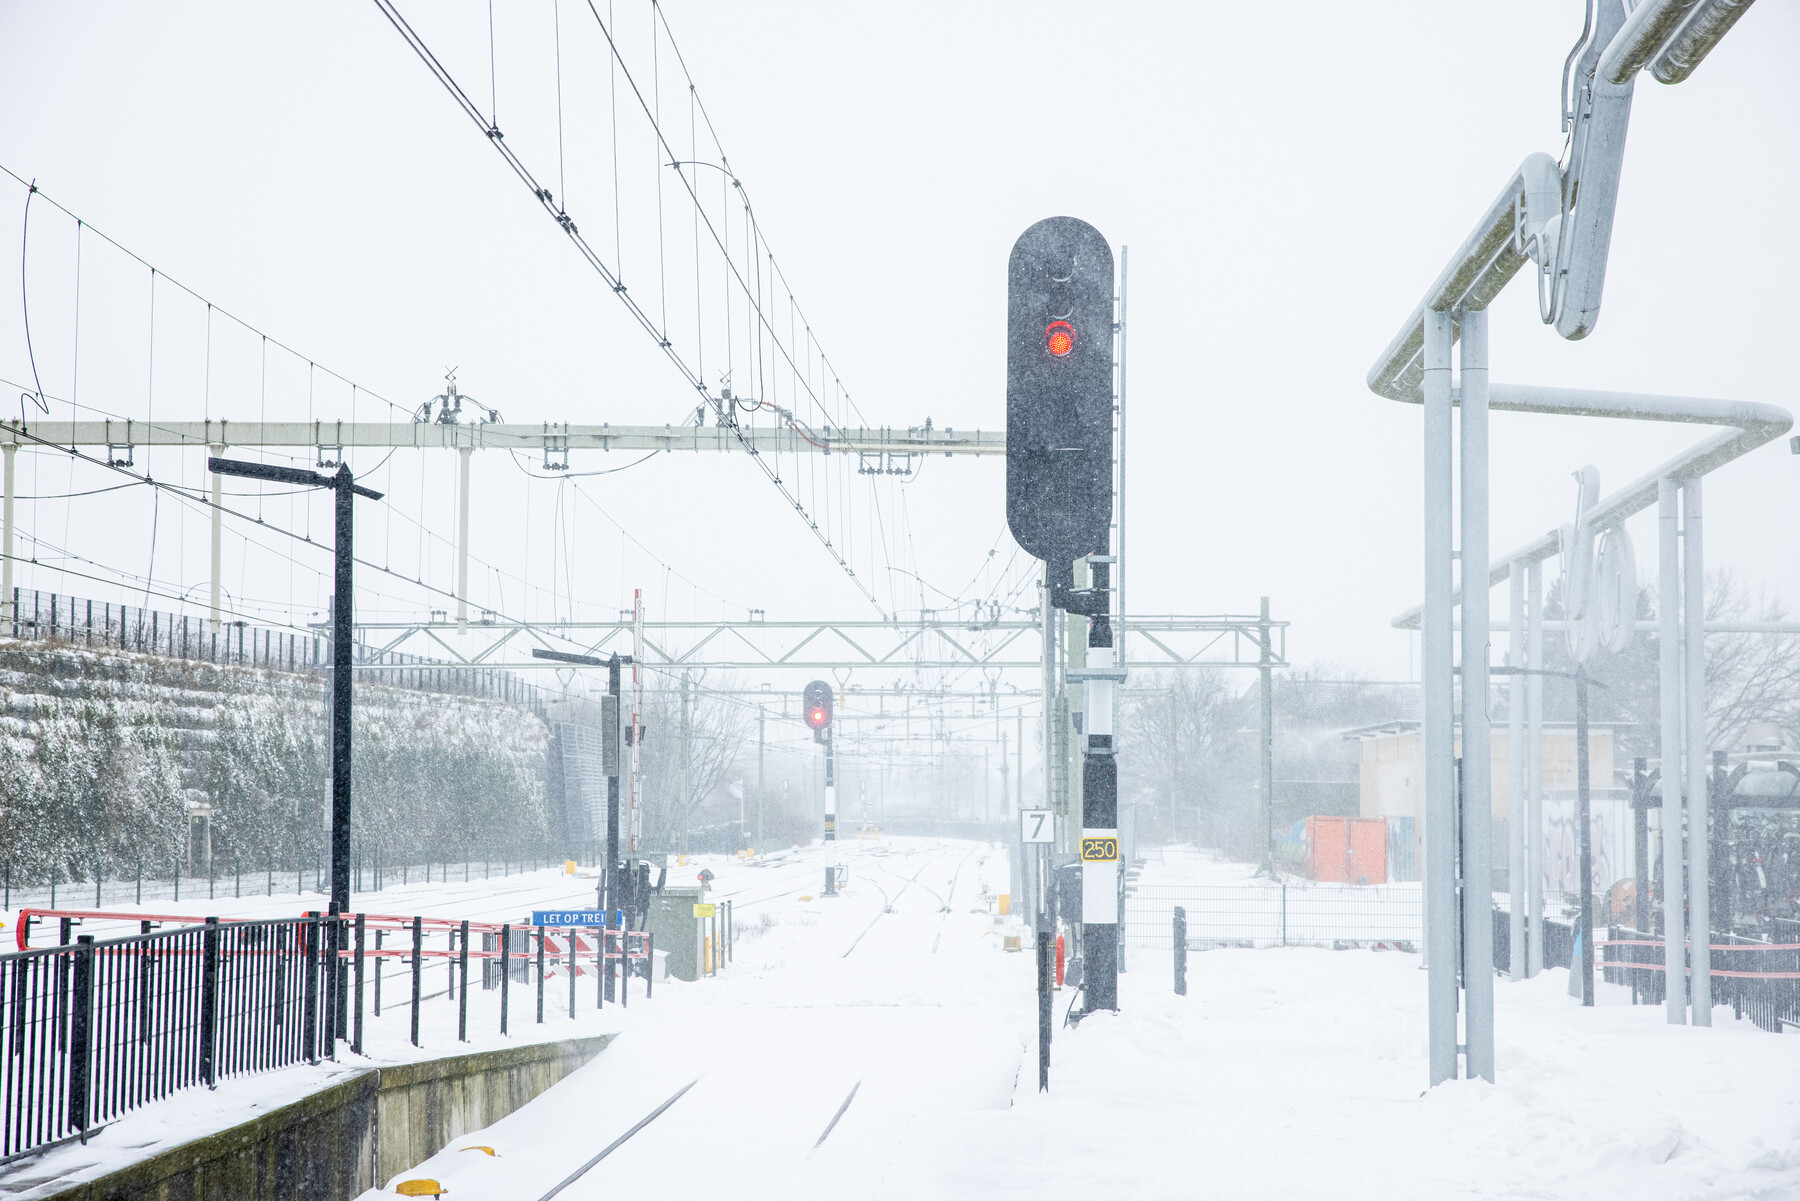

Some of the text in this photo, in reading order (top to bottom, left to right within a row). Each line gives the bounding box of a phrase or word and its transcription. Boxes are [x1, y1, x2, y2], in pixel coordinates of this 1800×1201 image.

[1030, 814, 1046, 839] 7
[1084, 841, 1115, 858] 250
[836, 867, 844, 880] 7
[543, 913, 607, 924] LET OP TREI
